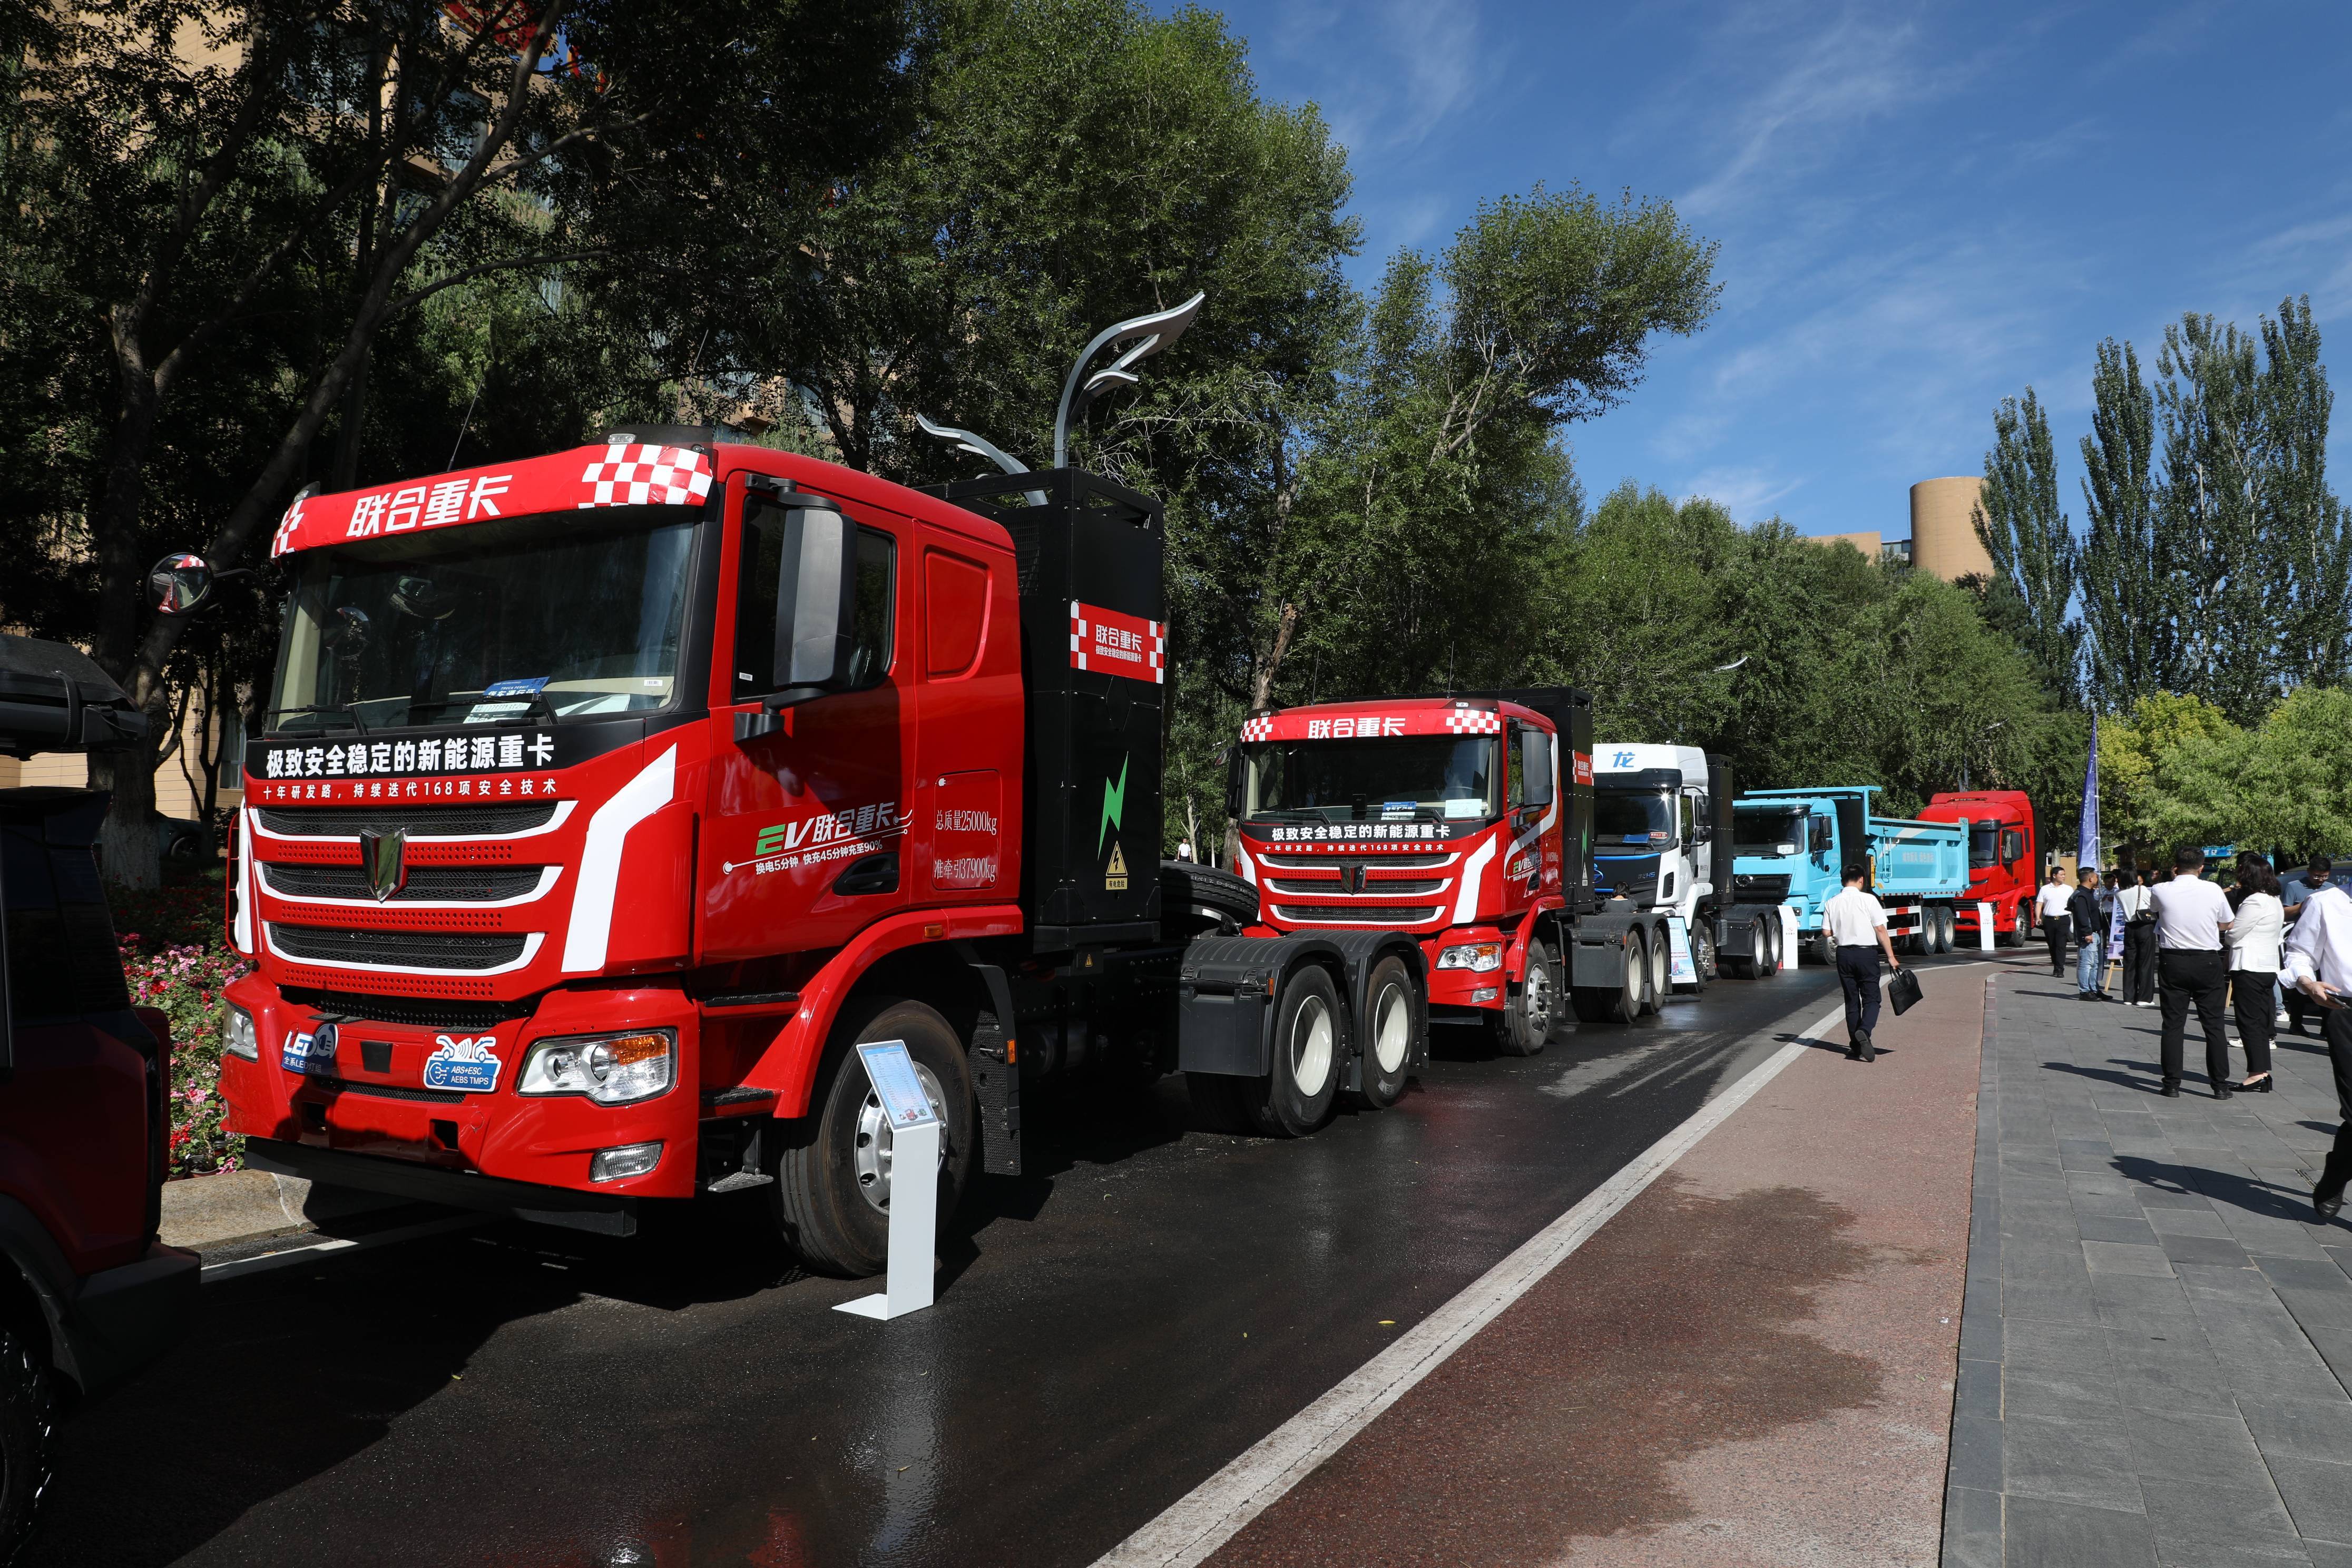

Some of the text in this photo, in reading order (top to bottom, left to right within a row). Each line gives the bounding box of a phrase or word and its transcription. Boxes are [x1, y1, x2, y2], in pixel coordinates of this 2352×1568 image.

[346, 475, 513, 537] 联合重卡
[1095, 624, 1142, 652] 联合重卡
[1095, 644, 1142, 663] 极致安全稳定的新能源重卡
[1307, 717, 1406, 739] 联合重卡
[266, 733, 554, 778] 极致安全稳定的新能源重卡
[935, 809, 997, 835] 总质量25000kg
[1272, 825, 1450, 841] 极致安全稳定的新能源重卡
[756, 839, 883, 875] 换电5分钟 快充45分钟充至90%
[934, 858, 995, 882] 准牵引37900kg
[283, 1030, 318, 1057] LED
[283, 1056, 322, 1073] 全系LED灯组
[451, 1066, 483, 1075] ABS+ESC
[450, 1075, 489, 1085] AEBS TMPS
